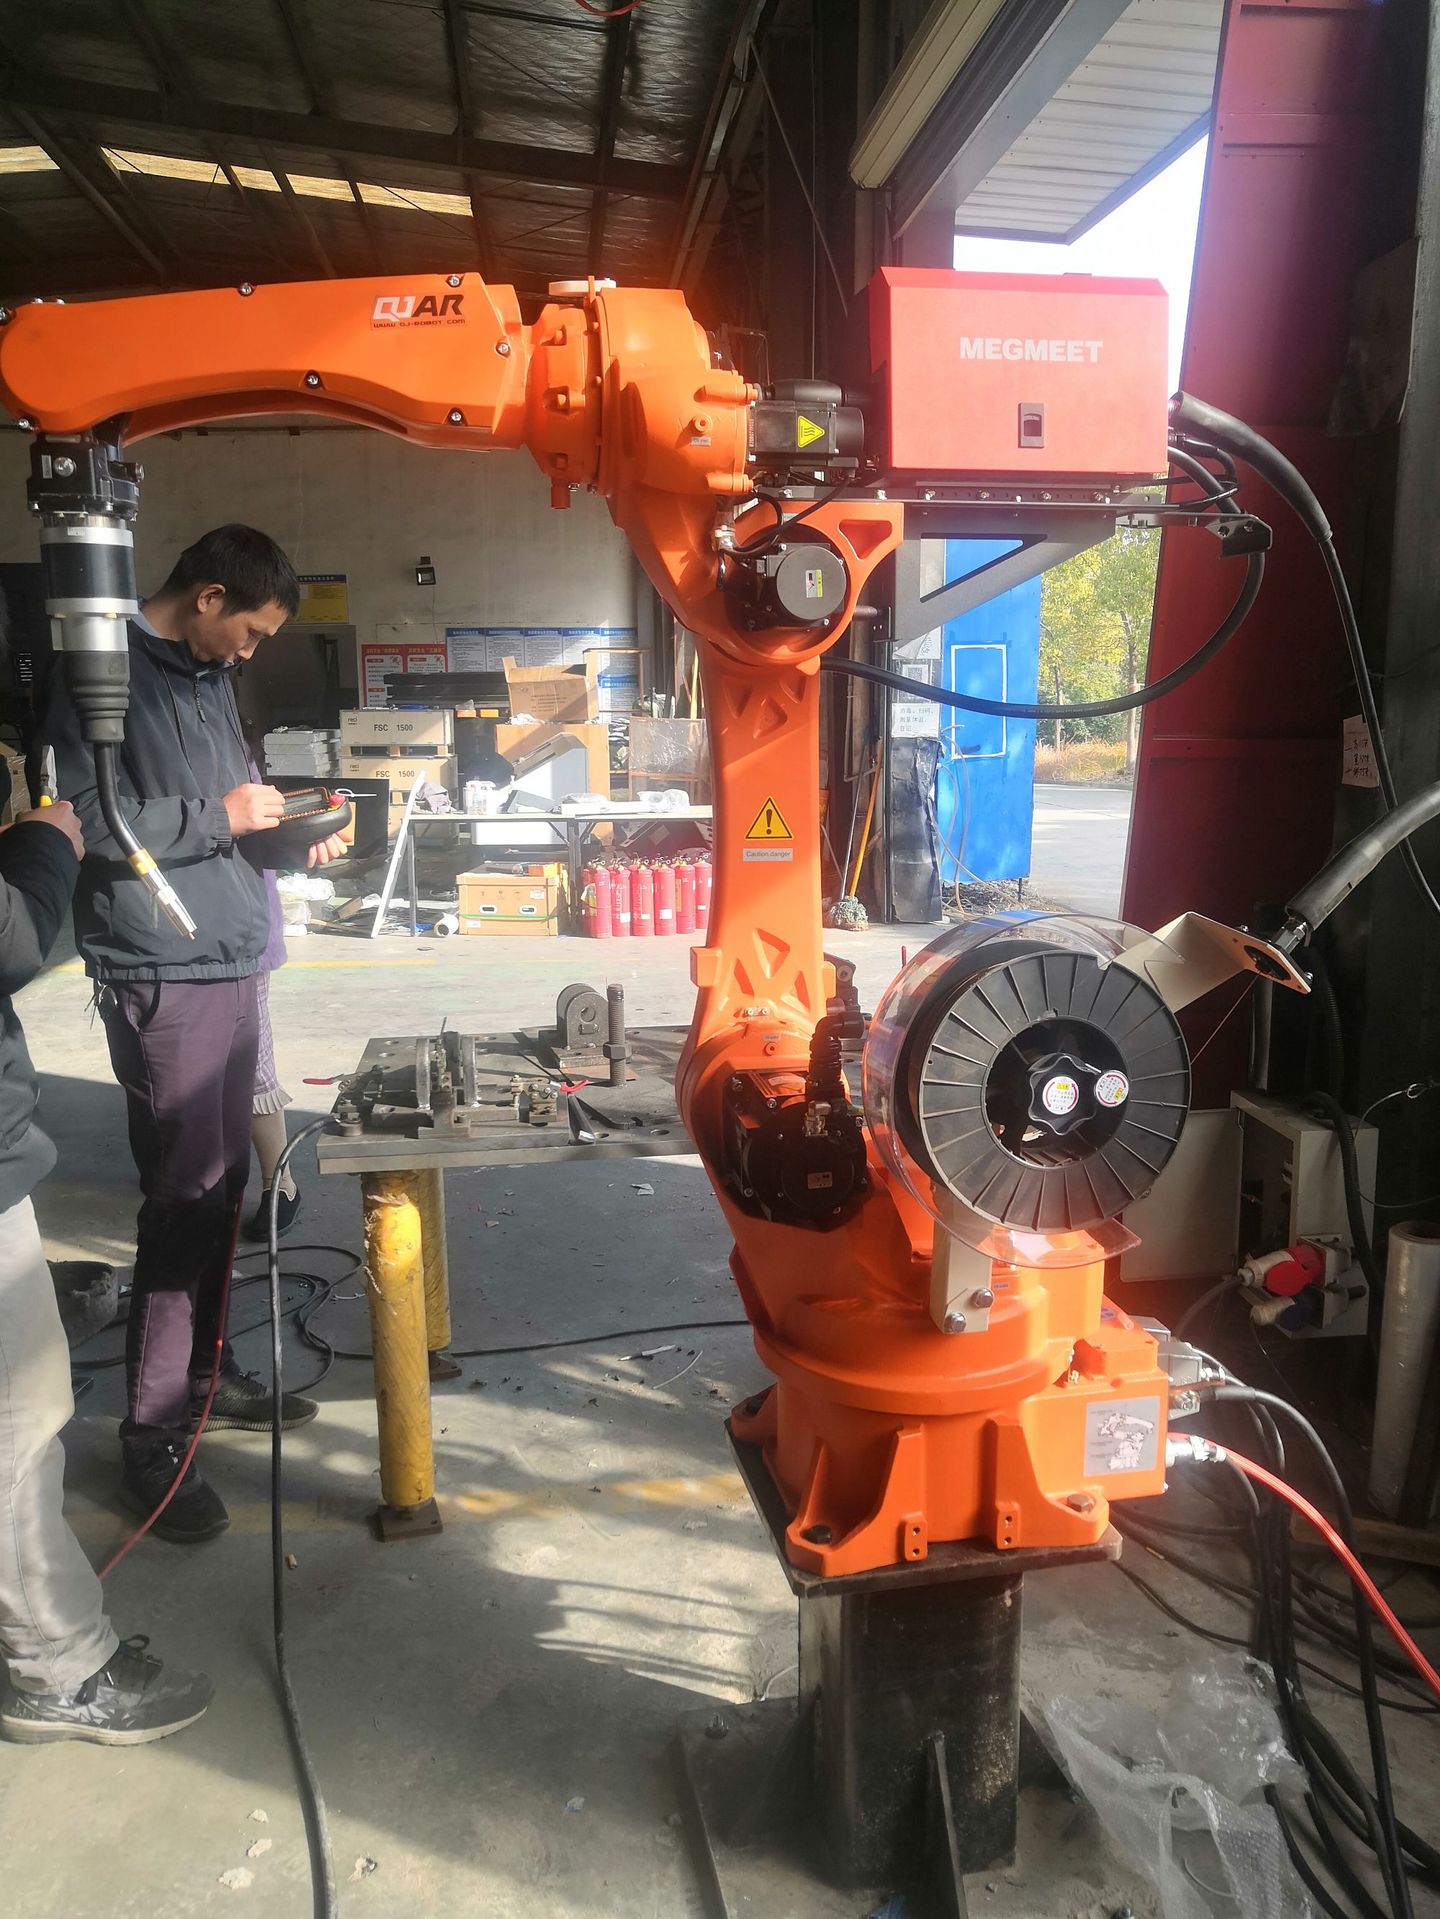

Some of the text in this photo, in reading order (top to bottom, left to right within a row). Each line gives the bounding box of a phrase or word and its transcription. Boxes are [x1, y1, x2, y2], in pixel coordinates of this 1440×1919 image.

[959, 336, 1104, 363] MEGMEET
[373, 724, 414, 732] FSC 1500
[375, 770, 415, 778] FSC 1500
